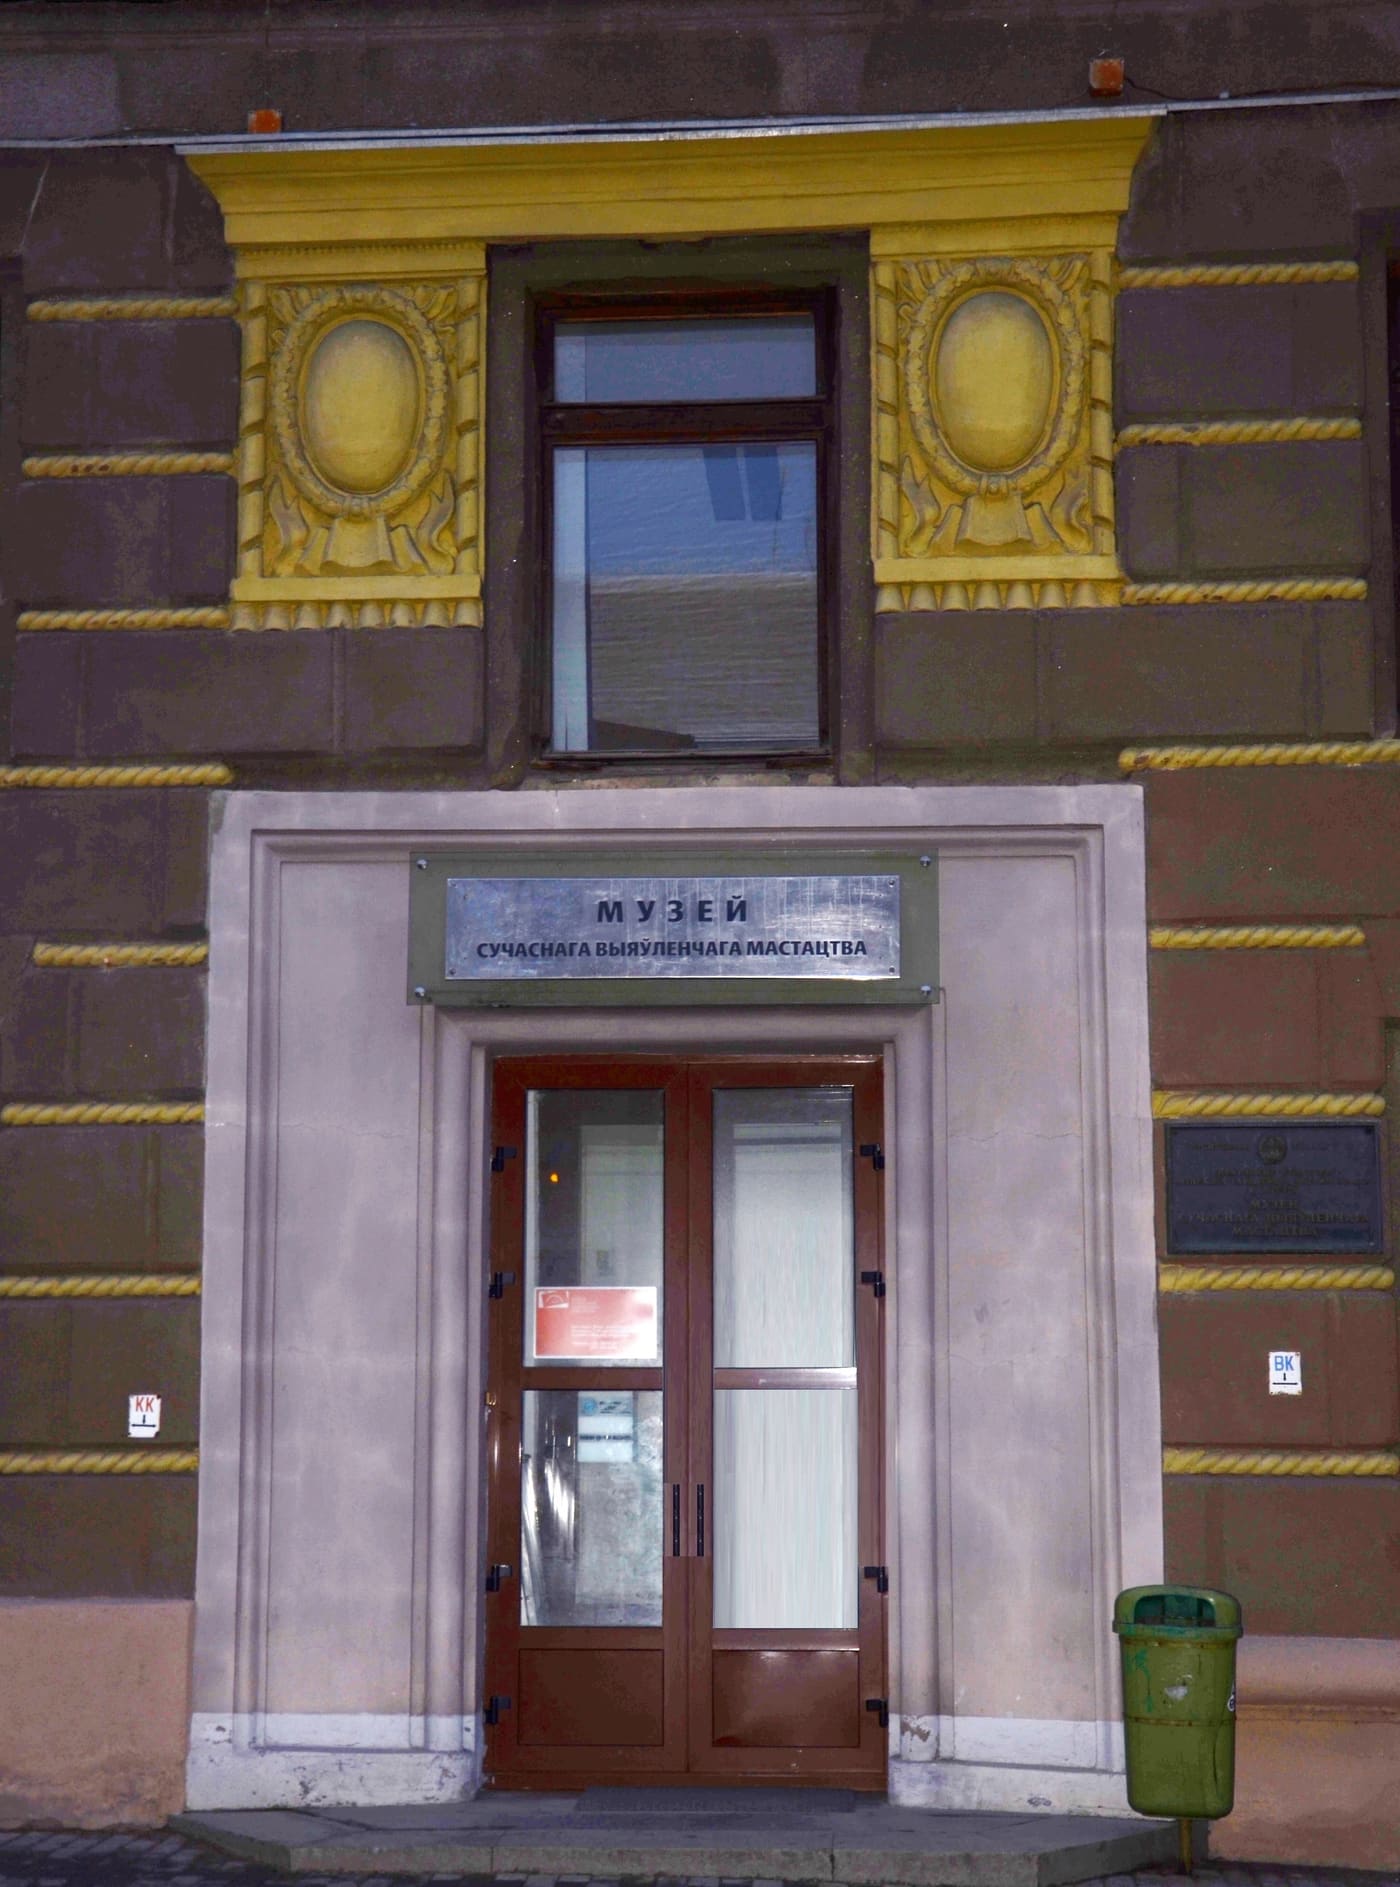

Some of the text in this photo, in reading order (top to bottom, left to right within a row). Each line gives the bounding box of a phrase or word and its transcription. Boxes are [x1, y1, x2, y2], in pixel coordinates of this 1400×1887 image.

[597, 895, 747, 923] МУЗЕЙ
[476, 938, 868, 958] СУЧАСНАГА ВЫЯЎЛЕНЧАГА МАСТАЦТВА
